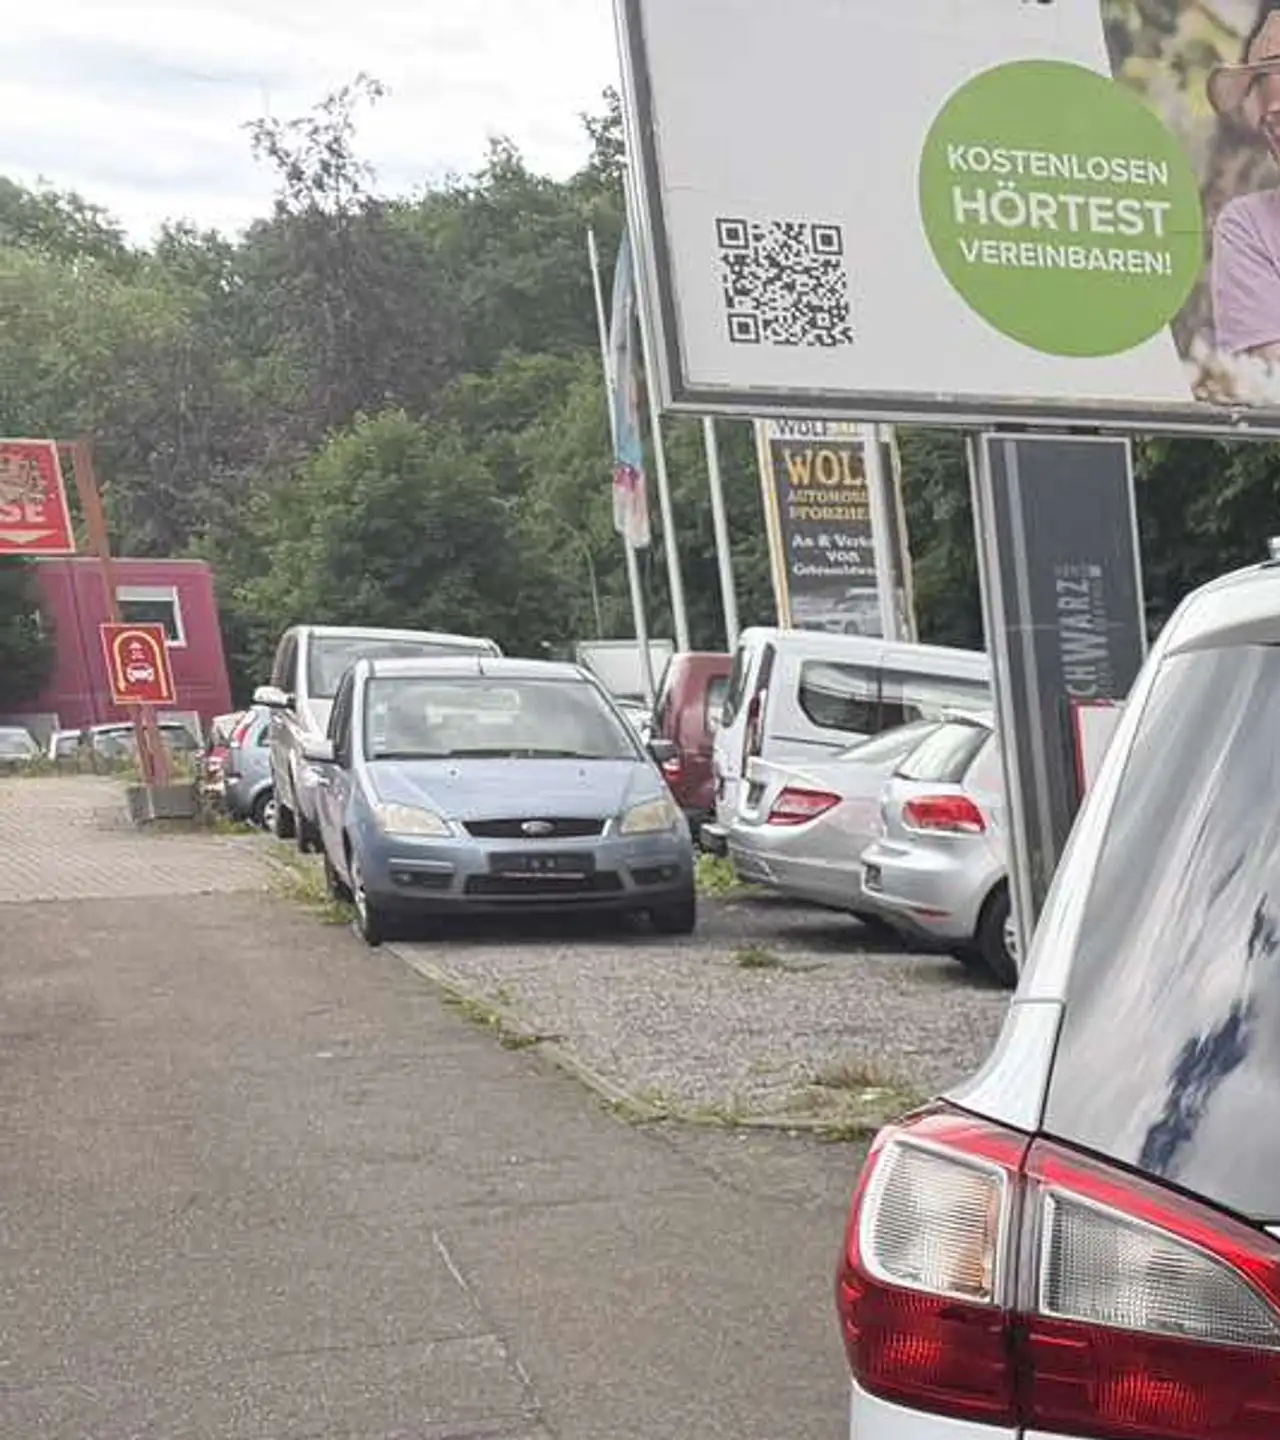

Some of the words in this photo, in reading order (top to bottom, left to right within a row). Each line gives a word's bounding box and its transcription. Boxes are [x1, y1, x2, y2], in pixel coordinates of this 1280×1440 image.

[948, 145, 1168, 186] KOSTENLOSEN
[953, 181, 1171, 236] HÖRTEST
[958, 237, 1173, 275] VEREINBAREN!
[784, 450, 869, 486] WOL
[789, 506, 872, 521] PFORZHE
[1056, 577, 1109, 698] CHWARZ
